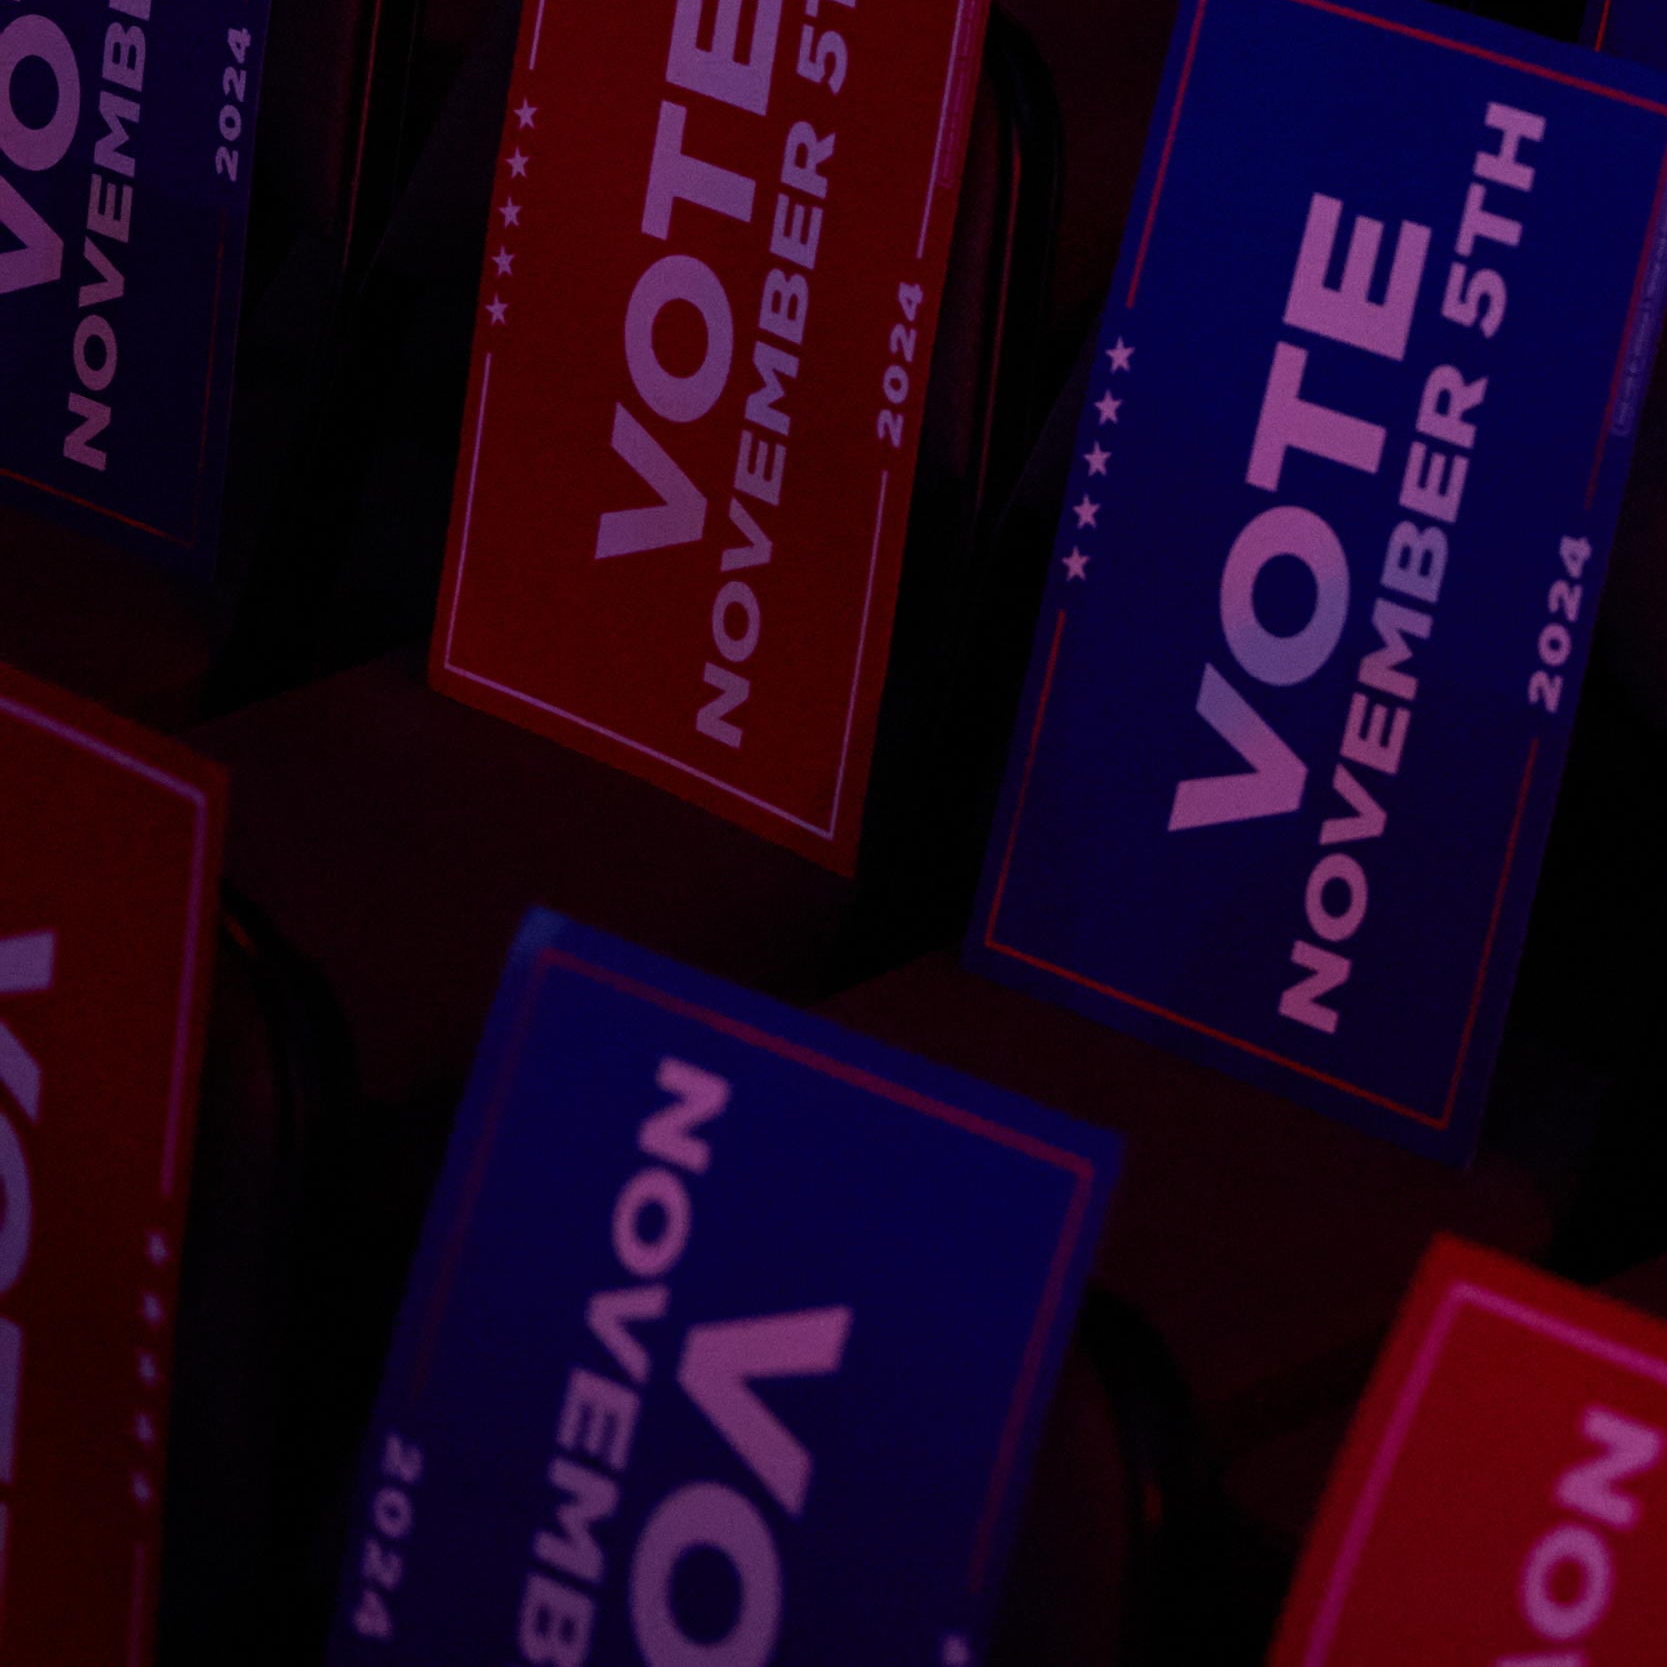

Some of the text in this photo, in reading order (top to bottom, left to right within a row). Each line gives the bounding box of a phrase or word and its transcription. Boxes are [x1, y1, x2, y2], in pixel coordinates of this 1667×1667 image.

[214, 27, 251, 182] 2024
[696, 121, 836, 748] NOVEMBER
[877, 282, 923, 447] 2024
[1167, 192, 1432, 832] VOTE
[1278, 102, 1546, 1034] NOVEMBER 5TH
[1528, 536, 1591, 713] 2024
[520, 1059, 728, 1667] NOVEMB
[631, 1307, 849, 1667] VO
